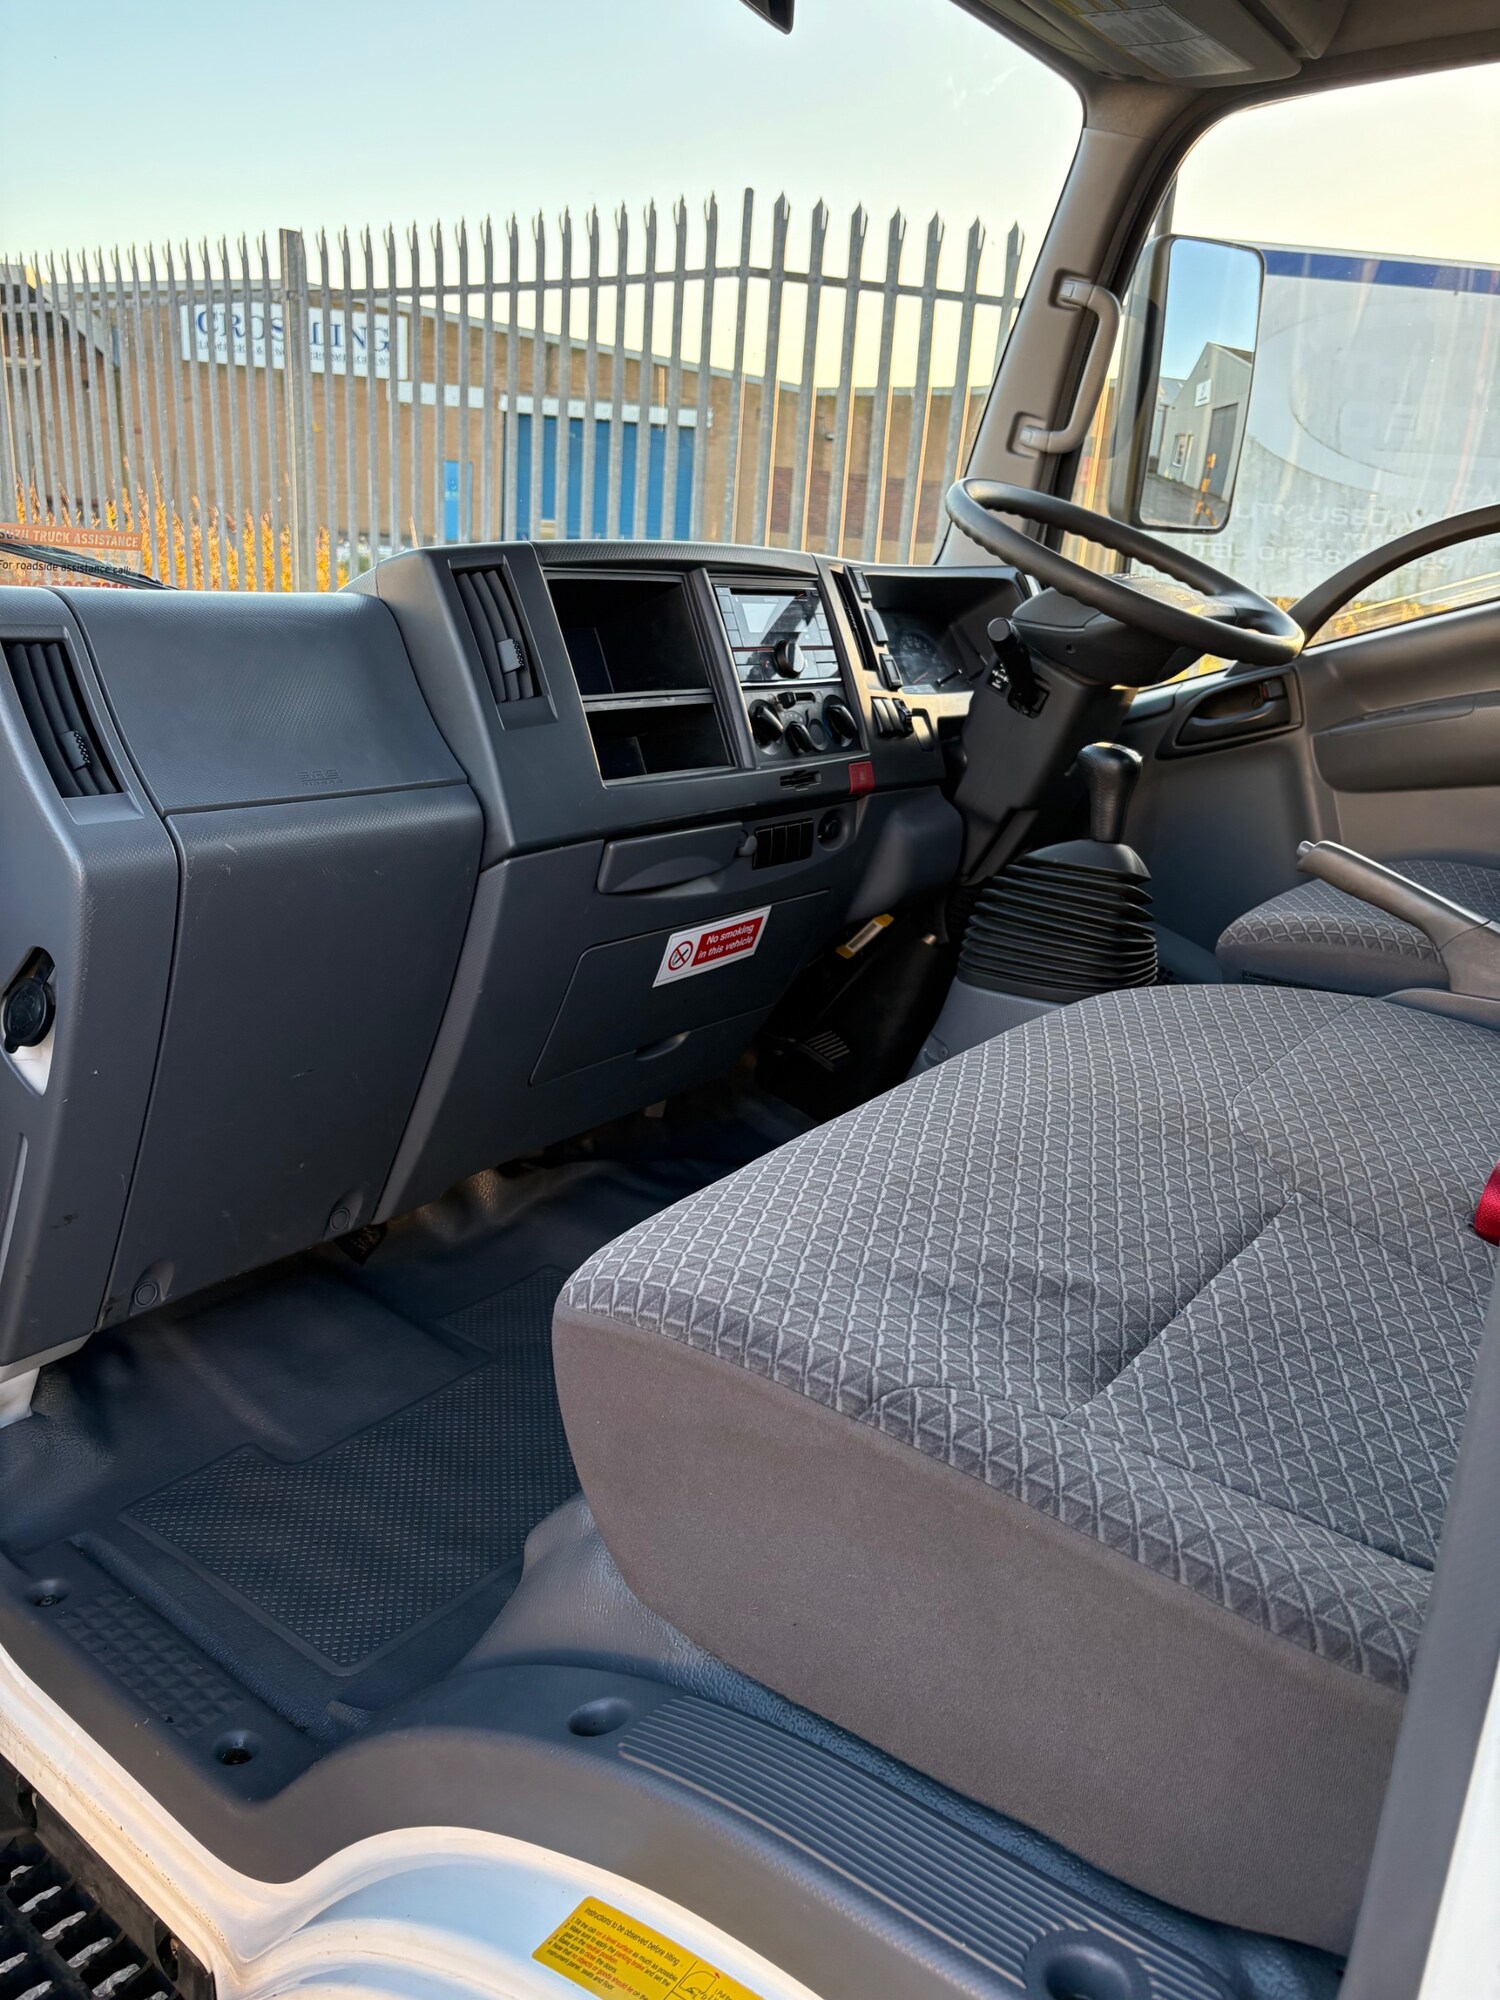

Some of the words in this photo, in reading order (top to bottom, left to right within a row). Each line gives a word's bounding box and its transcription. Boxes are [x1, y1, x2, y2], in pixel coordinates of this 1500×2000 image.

[197, 310, 391, 352] CROSLING
[1309, 506, 1391, 527] USED
[0, 527, 29, 540] SUZU
[33, 530, 70, 543] TRUCK
[73, 532, 139, 547] ASSISTANCE
[1258, 546, 1342, 565] 01228
[16, 561, 58, 571] roadside
[61, 562, 110, 574] assistance
[706, 934, 719, 945] No
[720, 924, 754, 941] smoking
[697, 950, 707, 960] in
[708, 944, 724, 956] this
[725, 935, 754, 951] vehicle
[585, 1907, 613, 1924] Instructions
[616, 1924, 626, 1932] be
[624, 1929, 649, 1945] observed
[647, 1942, 666, 1955] before
[664, 1952, 680, 1966] tilting
[638, 1955, 652, 1965] much
